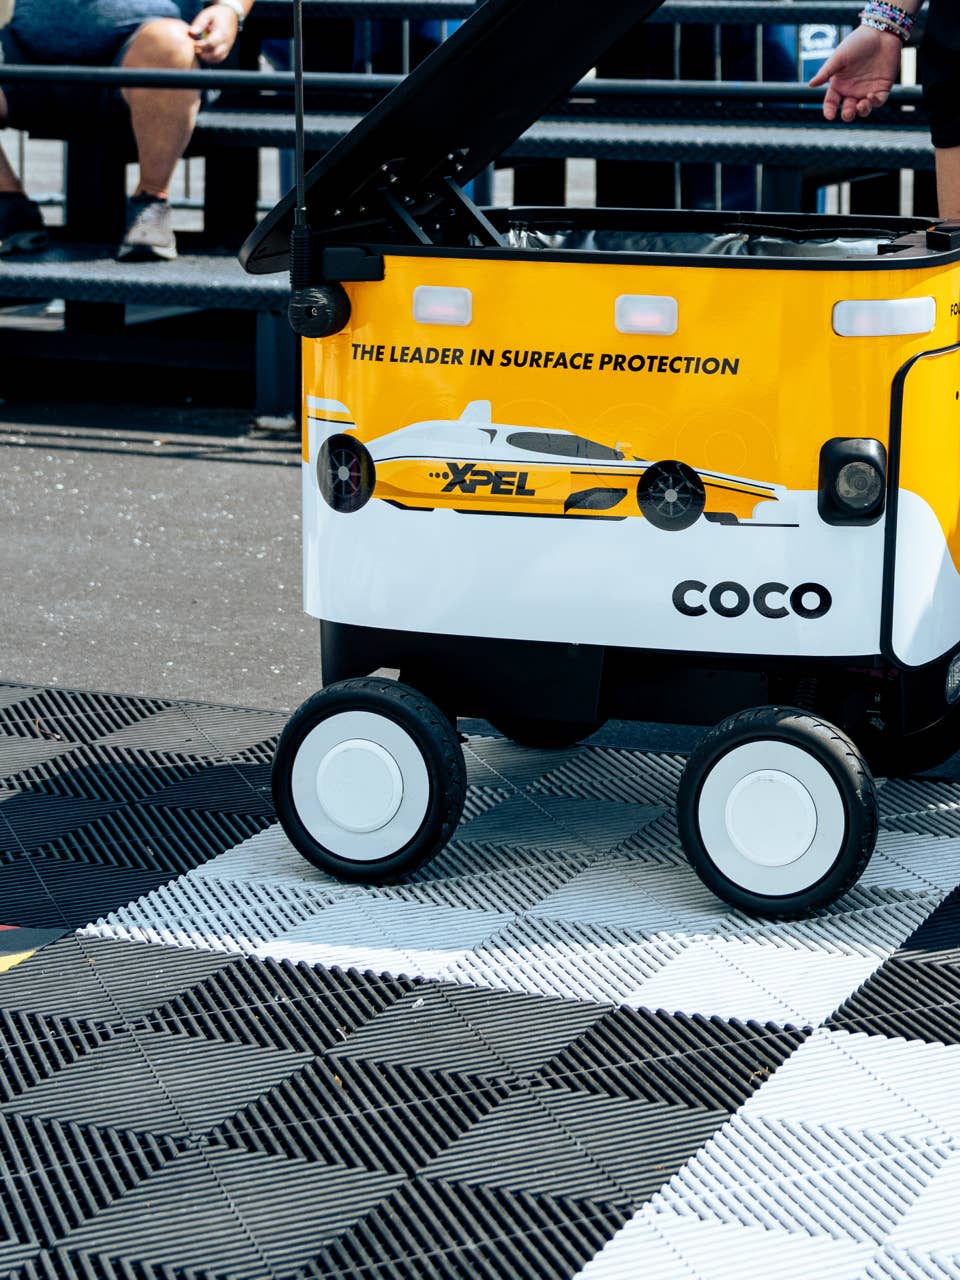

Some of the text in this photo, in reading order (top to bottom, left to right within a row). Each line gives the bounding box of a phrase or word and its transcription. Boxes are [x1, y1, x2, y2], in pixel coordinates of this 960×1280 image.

[352, 343, 740, 375] THE LEADER IN SURFACE PROTECTION
[441, 462, 536, 496] XPEL
[672, 579, 833, 619] COCO
